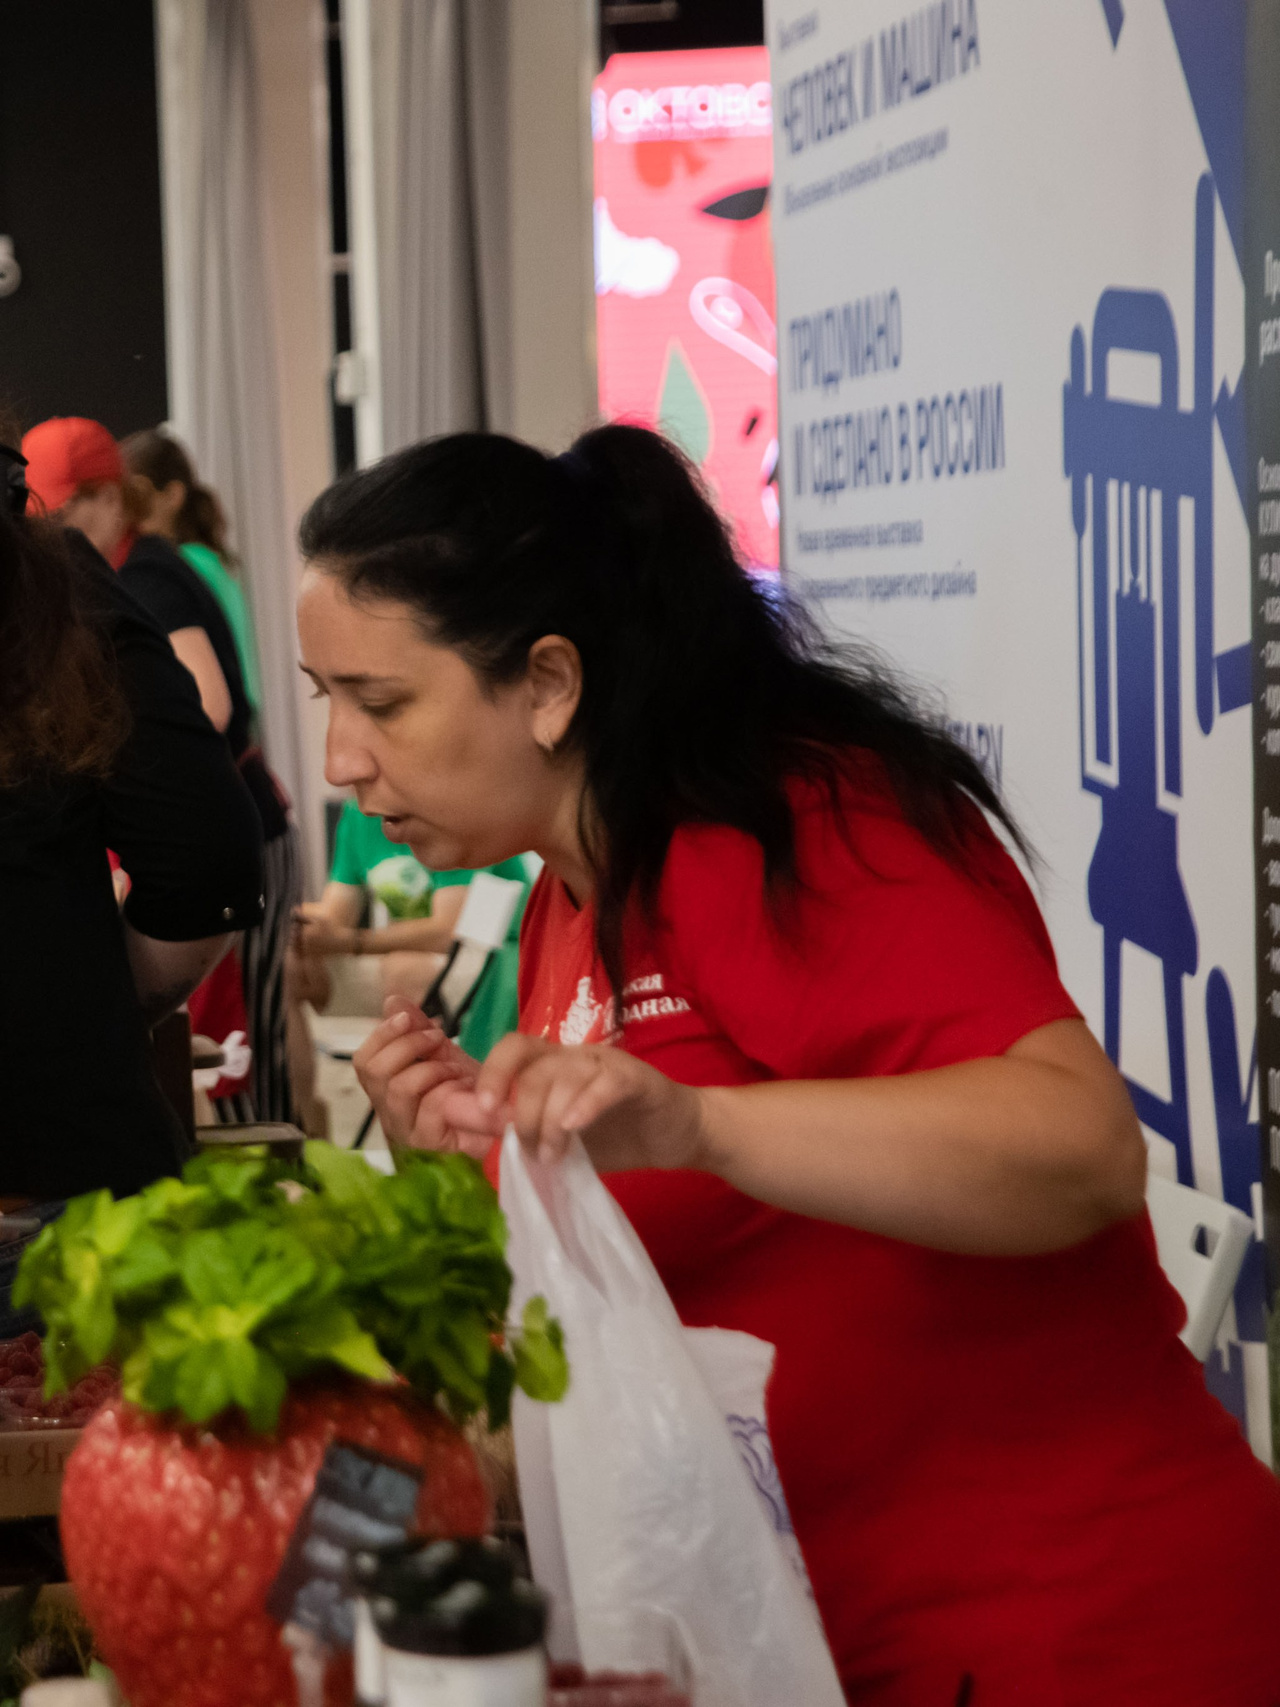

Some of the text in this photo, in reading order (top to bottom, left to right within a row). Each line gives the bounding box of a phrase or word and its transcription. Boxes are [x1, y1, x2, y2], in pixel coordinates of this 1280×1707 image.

[789, 286, 903, 396] ПРИДУМАНО
[810, 404, 893, 504] СДЕЛАНО
[898, 402, 911, 482] В
[917, 381, 1006, 481] РОССИИ
